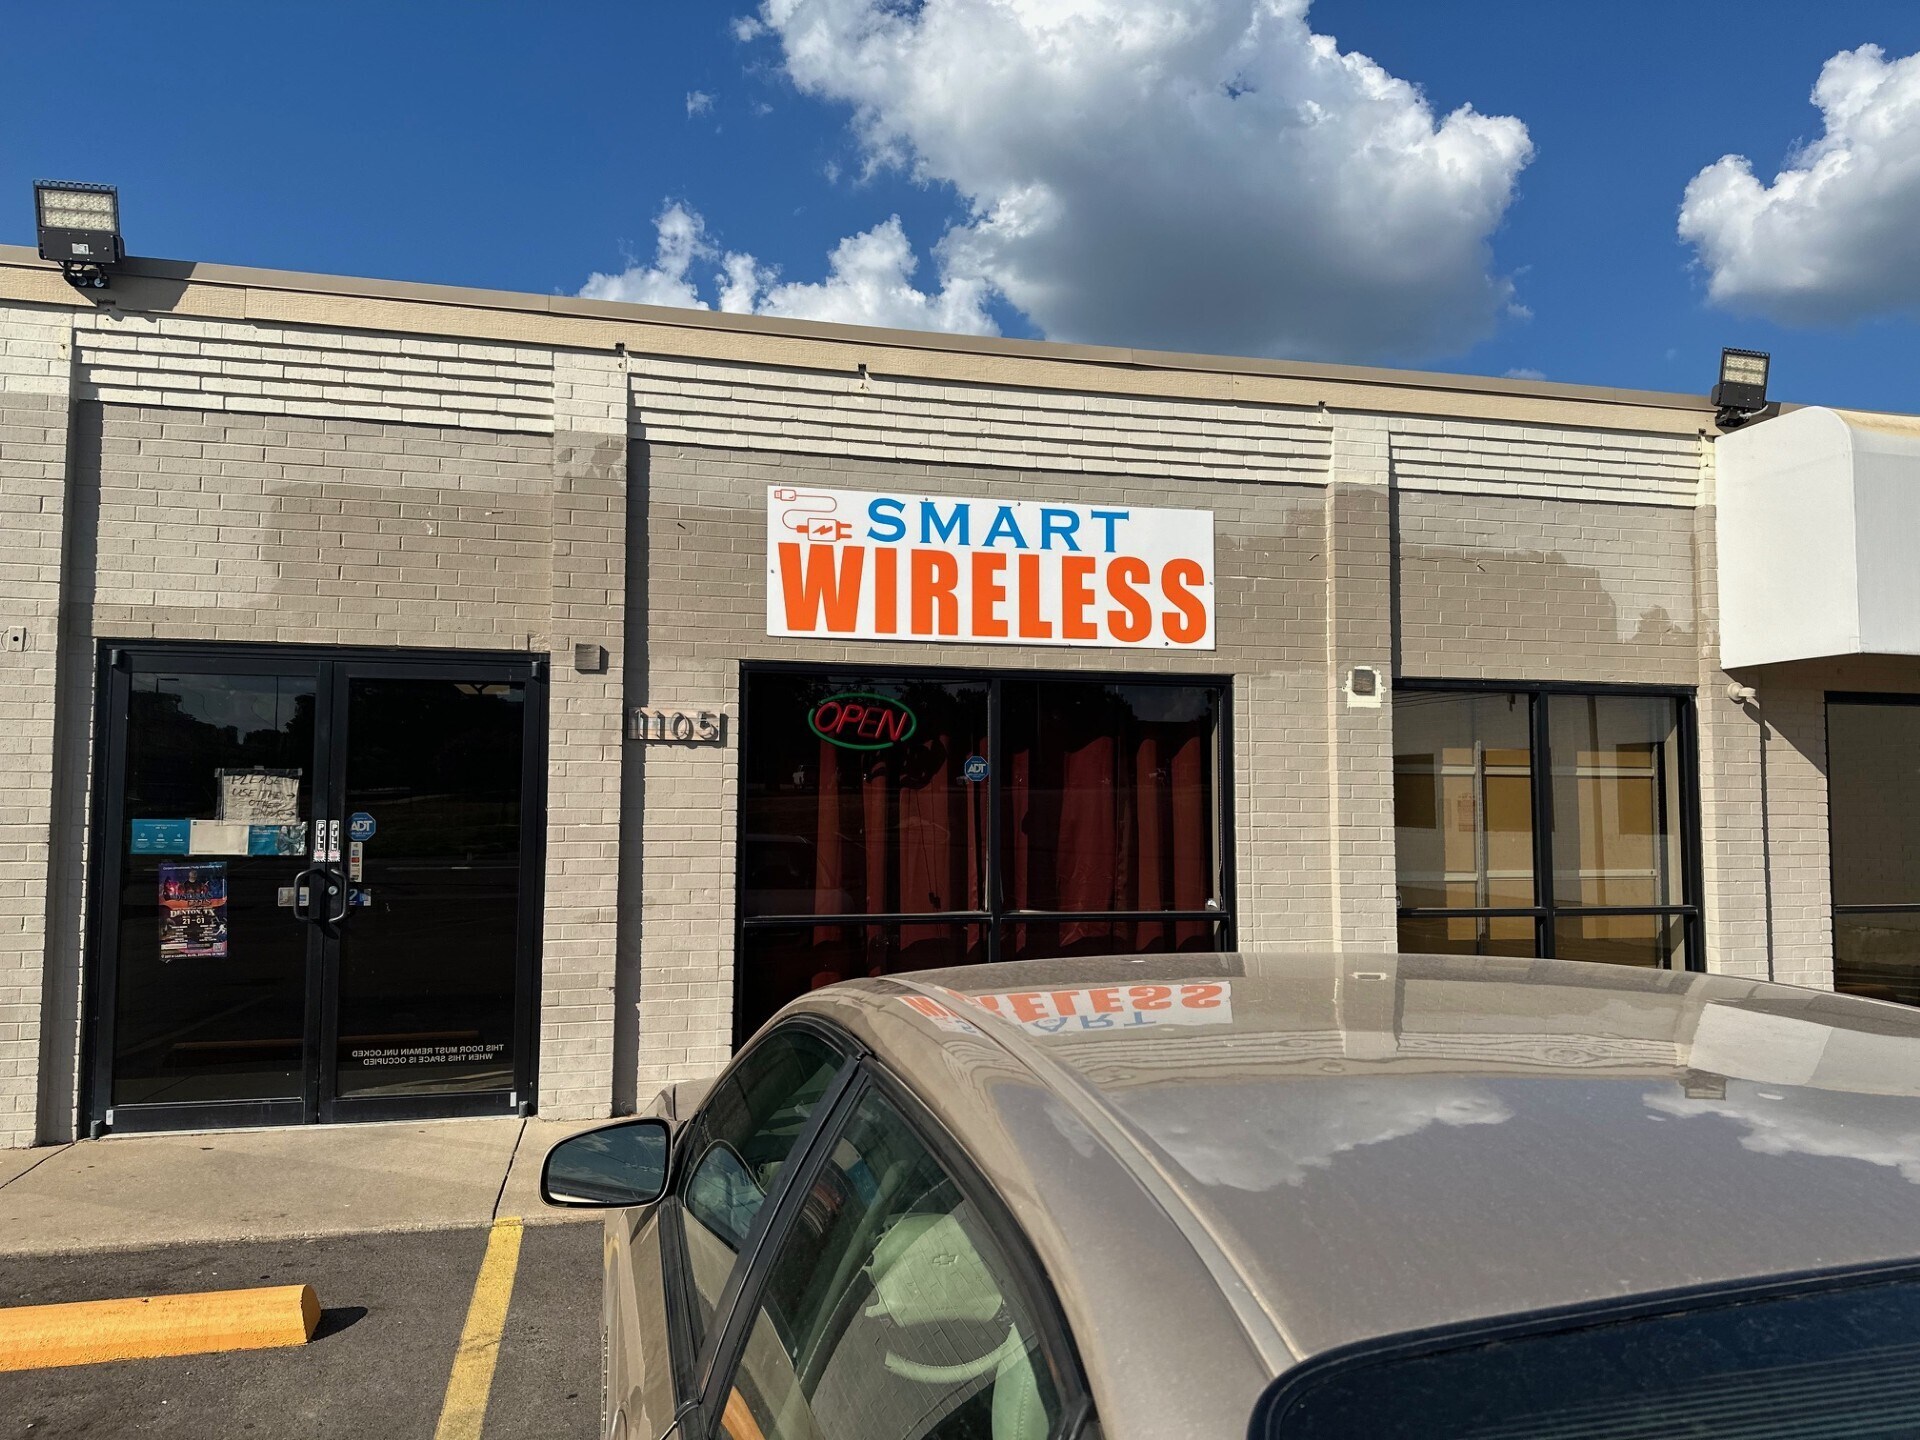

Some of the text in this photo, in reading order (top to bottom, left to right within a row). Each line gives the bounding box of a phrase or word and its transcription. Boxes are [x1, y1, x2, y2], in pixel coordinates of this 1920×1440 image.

[866, 498, 1130, 553] SMART
[778, 542, 1208, 644] WIRELESS
[634, 709, 718, 740] 1105
[814, 701, 908, 742] OPEN
[966, 763, 987, 773] ADT
[231, 775, 283, 785] PLEASE
[231, 788, 257, 797] USE
[248, 799, 282, 809] OTHER
[350, 820, 373, 832] ADT
[317, 823, 325, 850] PULL
[203, 908, 216, 916] TX
